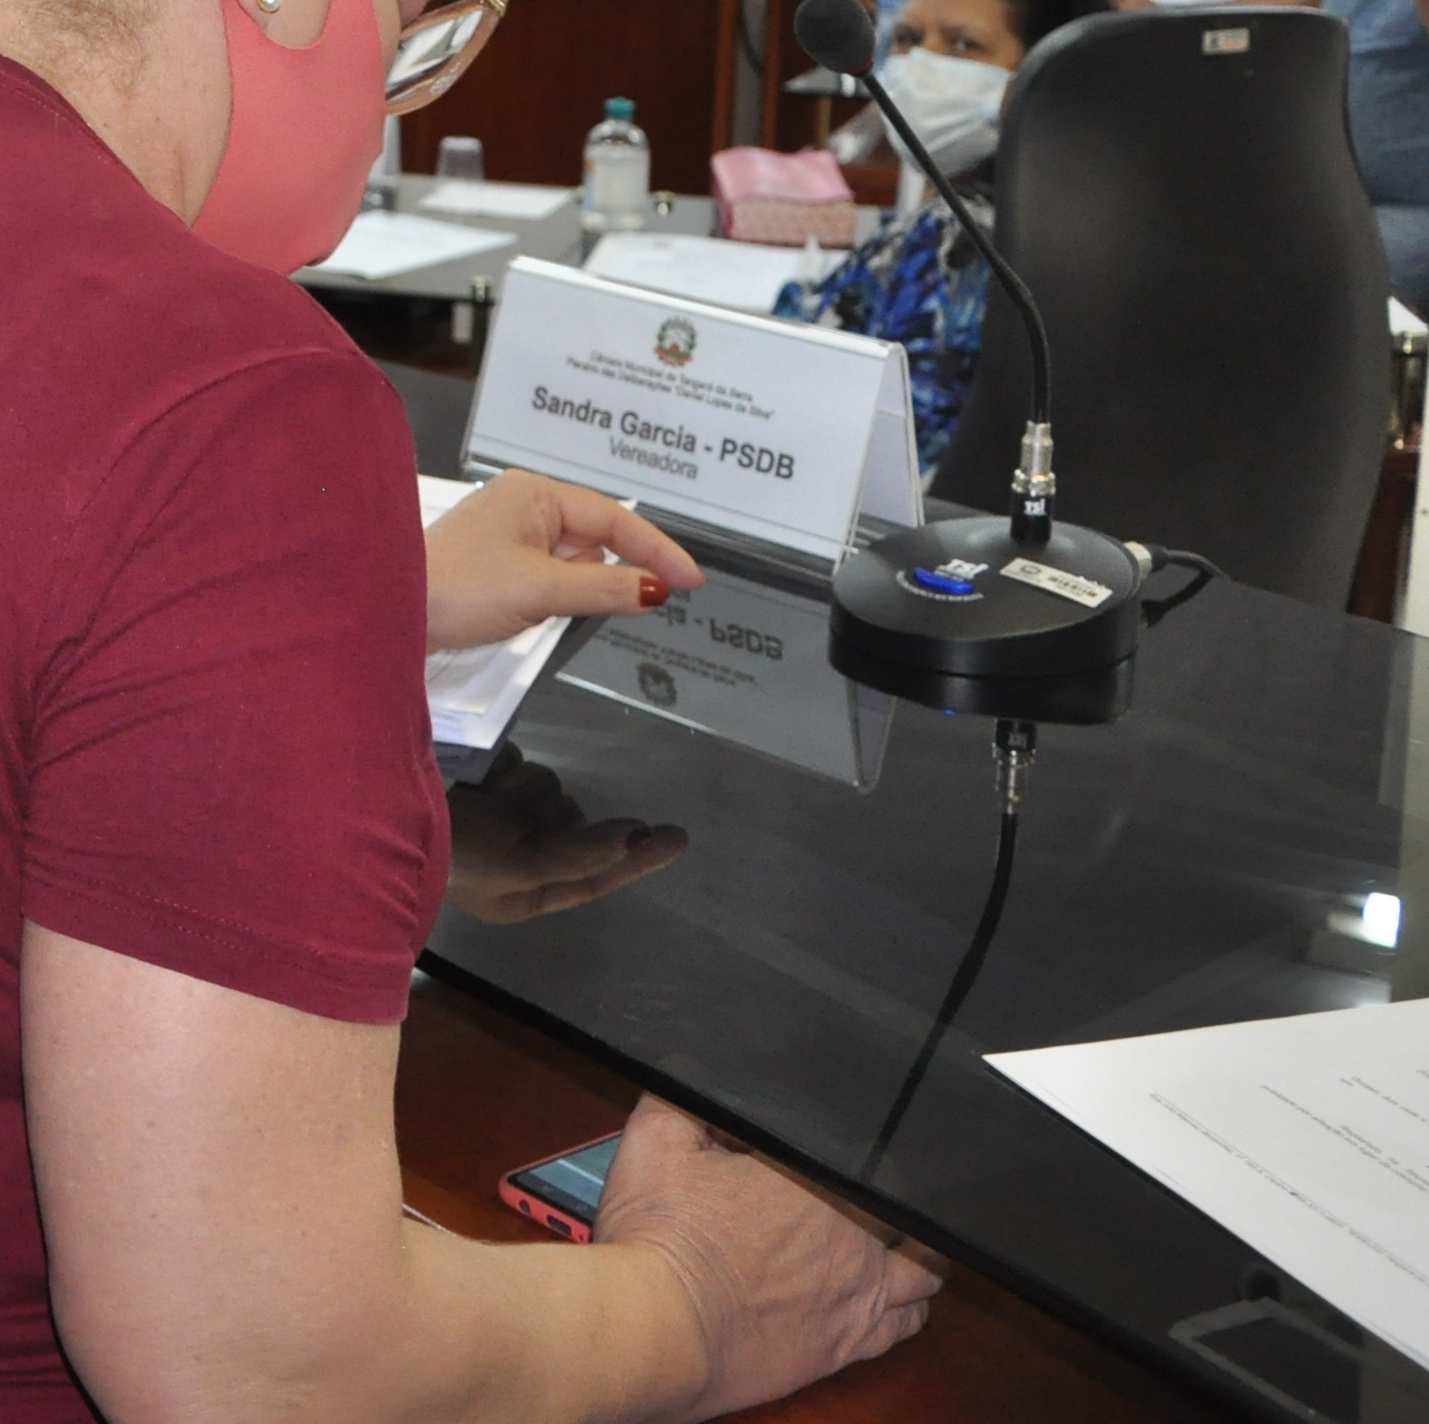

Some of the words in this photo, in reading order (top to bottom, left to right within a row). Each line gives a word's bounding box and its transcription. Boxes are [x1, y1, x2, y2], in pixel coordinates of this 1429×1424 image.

[532, 385, 613, 430] Sandra
[620, 410, 697, 453] Garcia
[719, 437, 795, 480] PSDB
[610, 436, 699, 480] Vereadora
